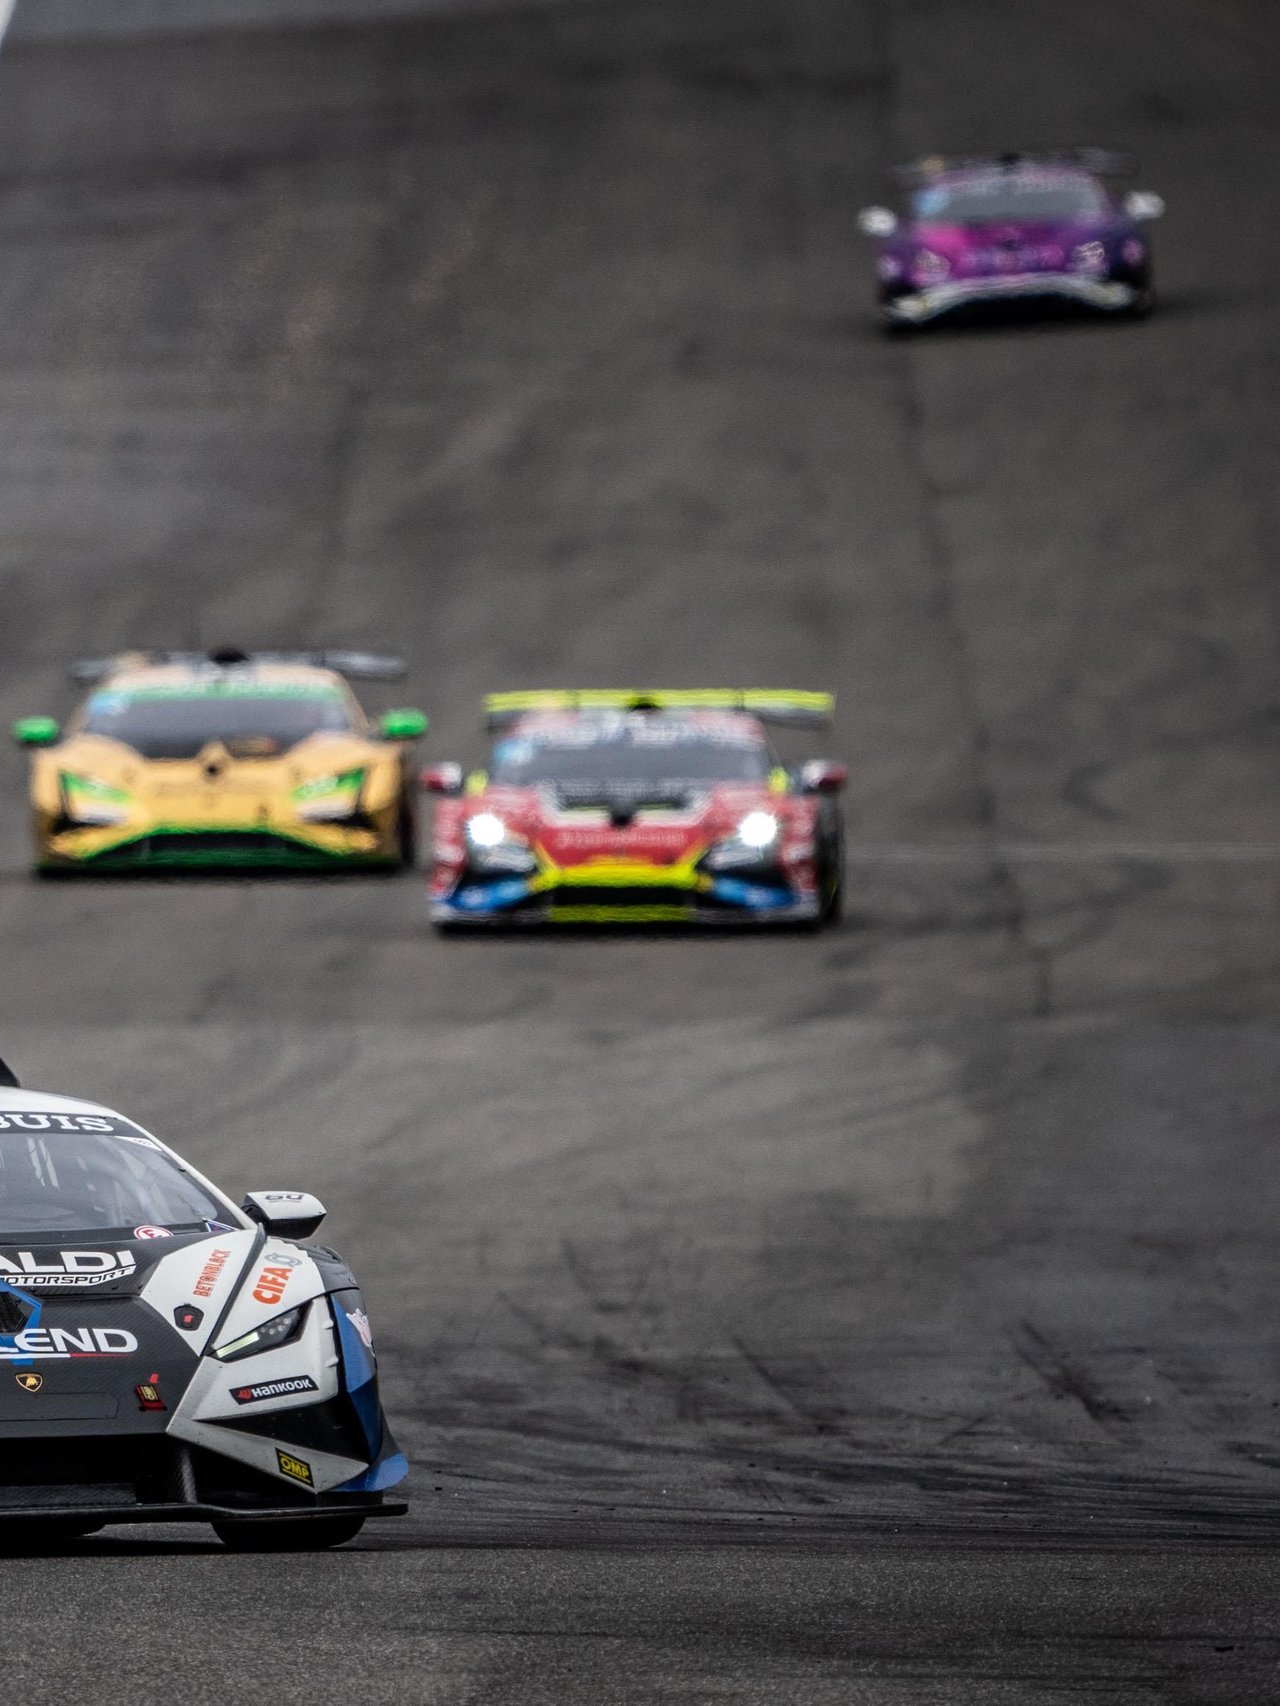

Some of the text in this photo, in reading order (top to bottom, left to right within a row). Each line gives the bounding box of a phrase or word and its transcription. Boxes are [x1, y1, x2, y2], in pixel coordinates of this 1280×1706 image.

[193, 1249, 232, 1298] BETONBLOCK
[252, 1266, 294, 1305] CIFA
[280, 1456, 309, 1478] OMP
